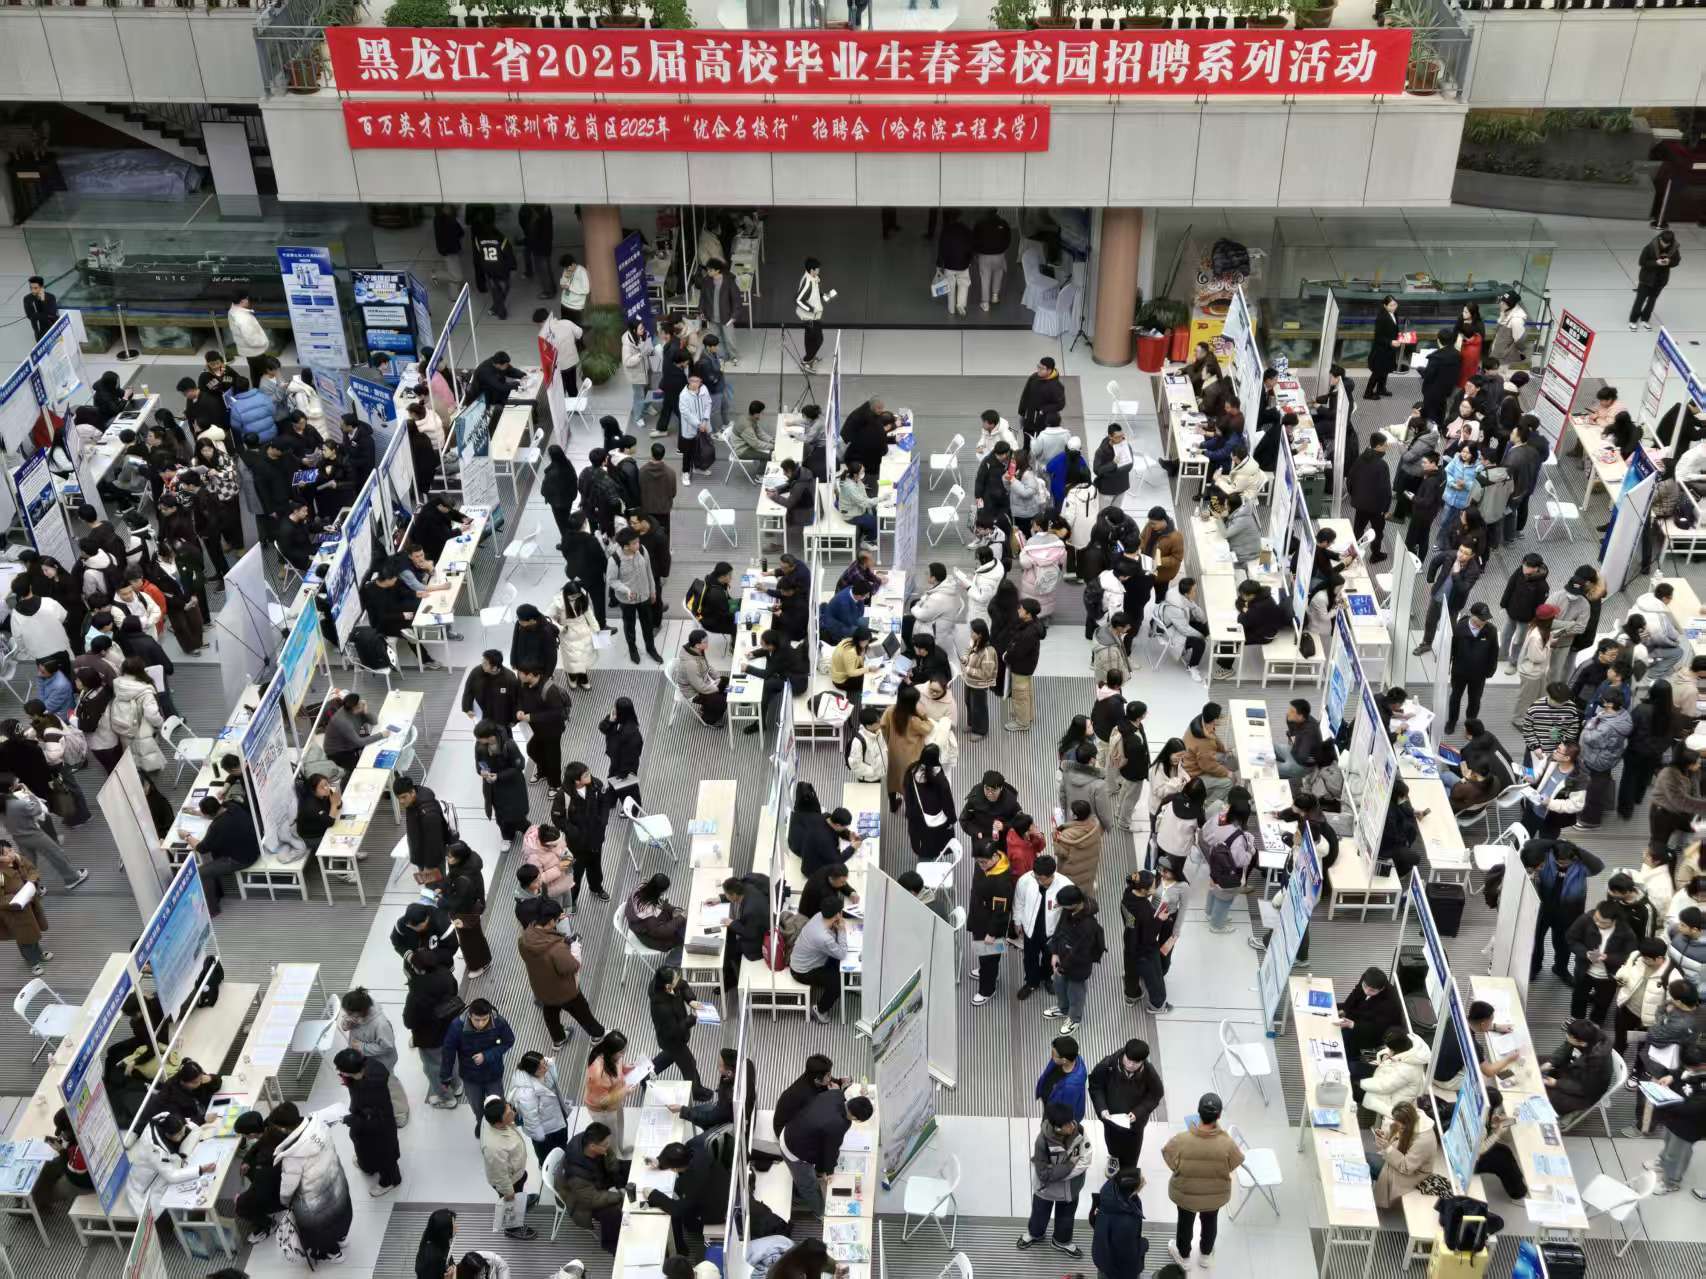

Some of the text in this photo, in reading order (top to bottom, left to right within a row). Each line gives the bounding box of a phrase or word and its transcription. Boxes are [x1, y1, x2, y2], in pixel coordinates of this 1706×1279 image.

[357, 38, 1377, 84] 黑龙江省2025届高校毕业生春季校园招聘系列活动
[483, 247, 498, 261] 12
